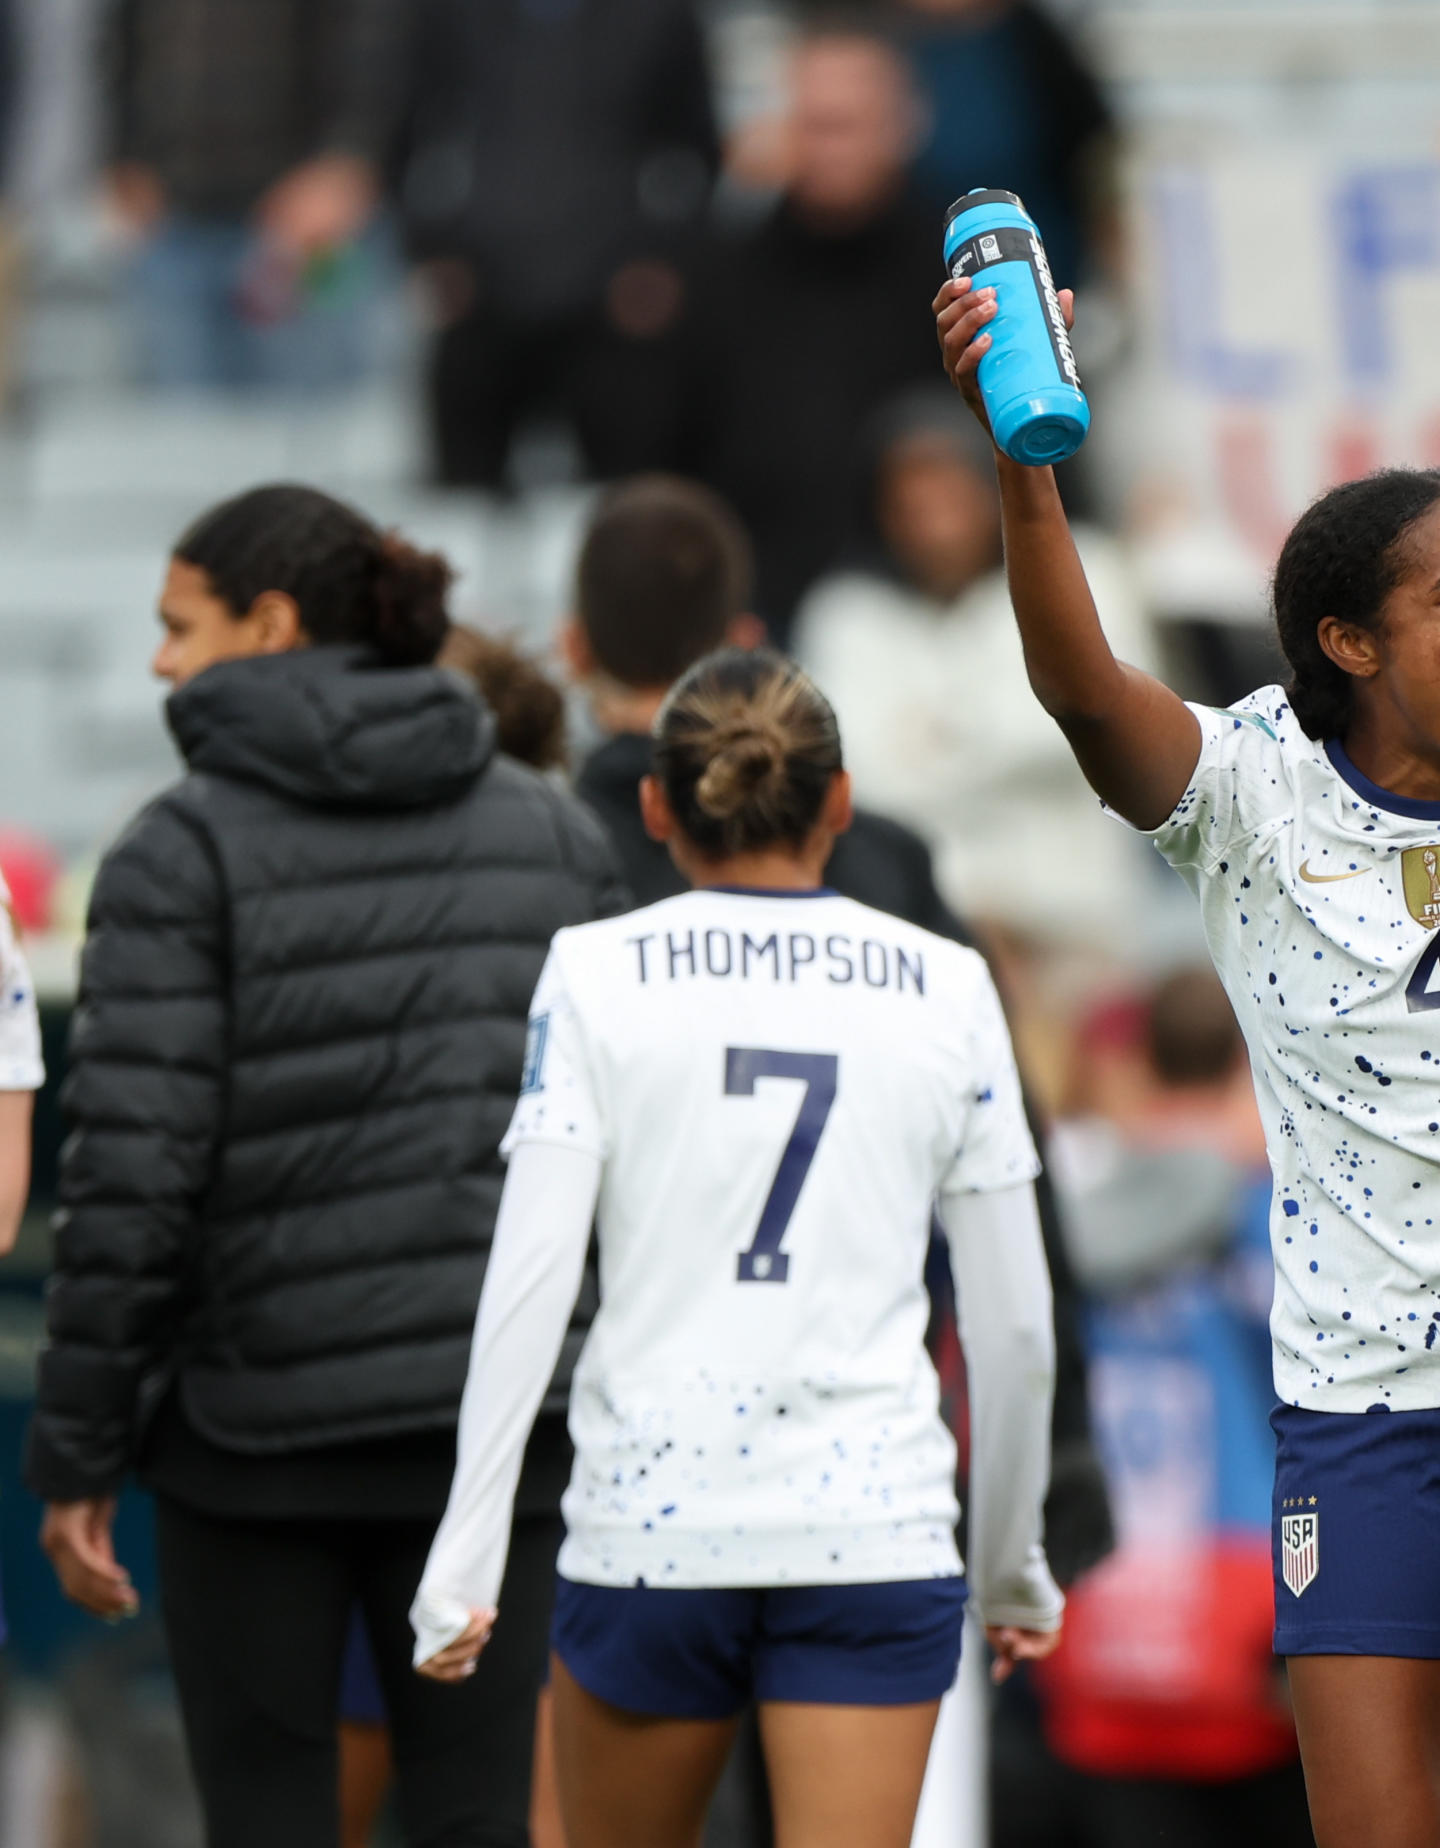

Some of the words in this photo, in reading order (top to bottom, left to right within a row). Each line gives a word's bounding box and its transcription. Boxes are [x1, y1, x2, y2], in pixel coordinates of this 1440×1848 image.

[627, 928, 927, 996] THOMPSON
[723, 1047, 838, 1282] 7
[1284, 1518, 1313, 1549] USA
